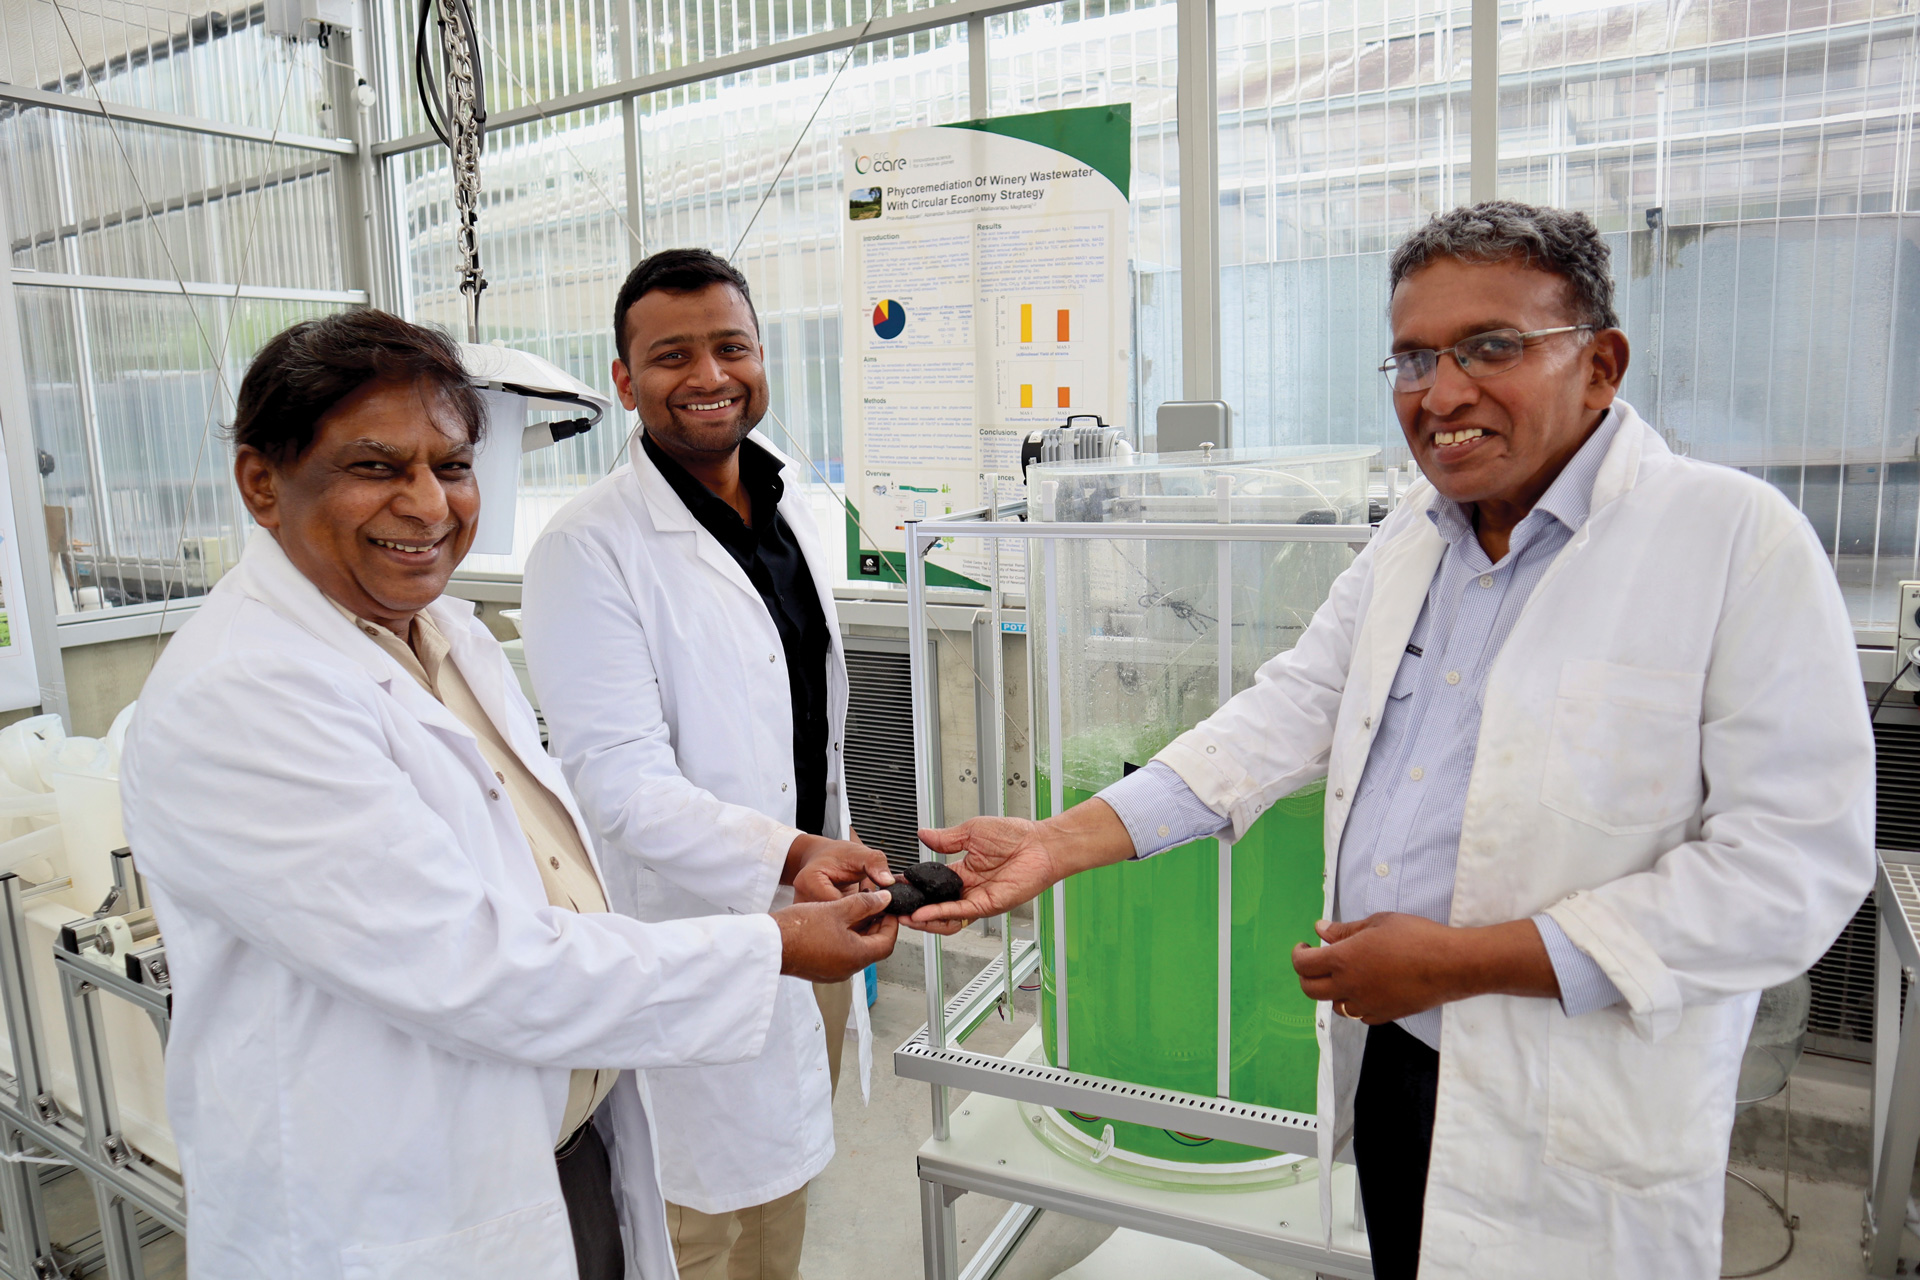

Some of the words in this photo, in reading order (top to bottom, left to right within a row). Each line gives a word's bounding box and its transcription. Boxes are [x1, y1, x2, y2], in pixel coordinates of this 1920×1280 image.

[873, 151, 889, 160] crc
[873, 158, 907, 173] care
[887, 180, 972, 198] Phycoremediation
[975, 176, 987, 187] Of
[989, 174, 1027, 187] Winery
[1030, 168, 1094, 182] Wastewater
[887, 200, 909, 211] With
[911, 197, 948, 209] Circular
[951, 193, 996, 206] Economy
[1000, 188, 1045, 201] Strategy
[976, 222, 1002, 231] Results
[863, 233, 900, 242] Introduction
[979, 428, 1018, 436] Conclusions
